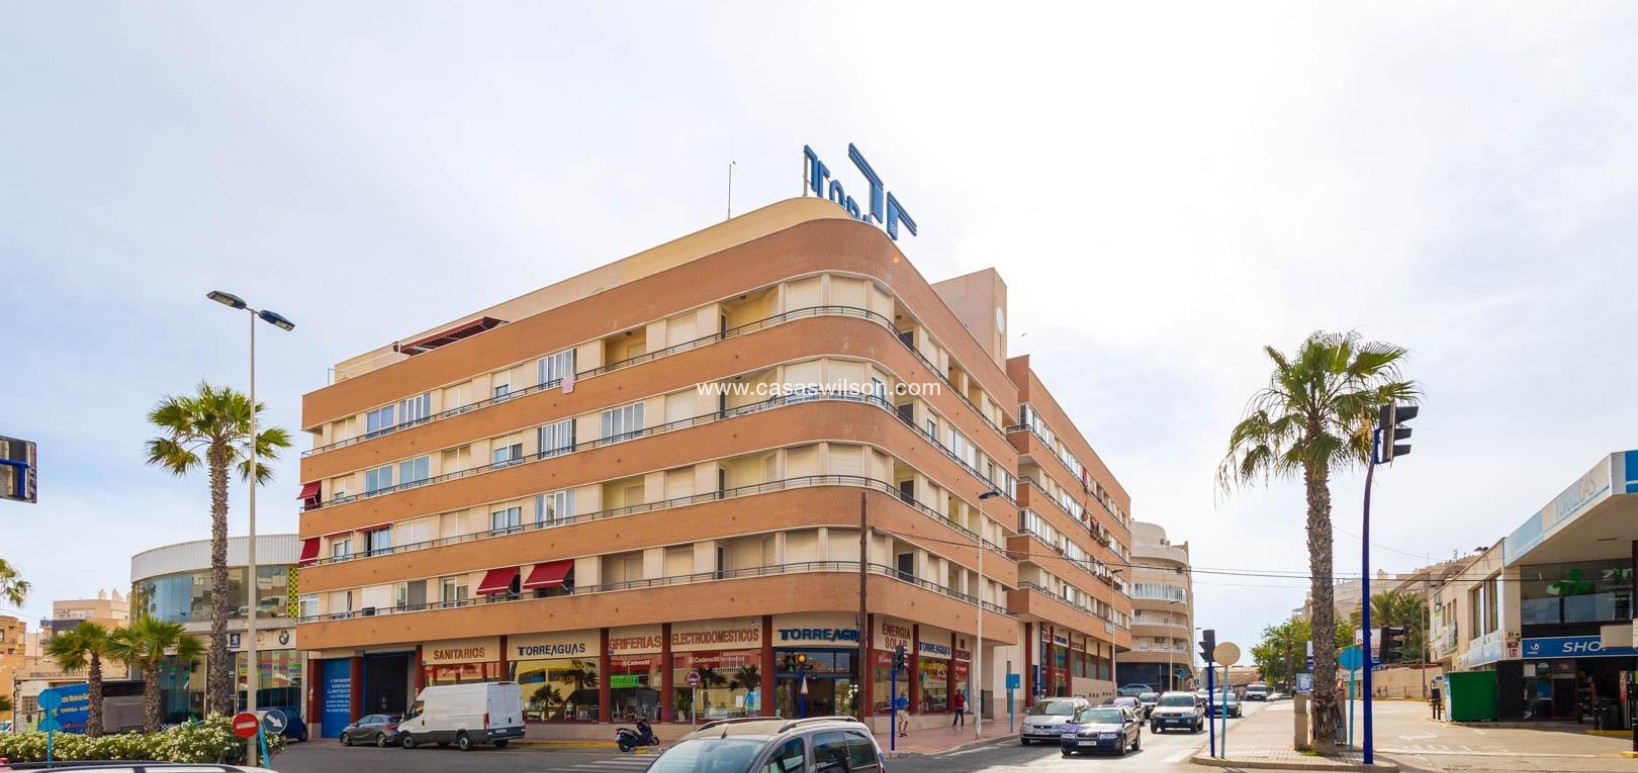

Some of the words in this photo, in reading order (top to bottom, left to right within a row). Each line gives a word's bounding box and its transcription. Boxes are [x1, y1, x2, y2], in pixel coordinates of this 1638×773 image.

[434, 646, 485, 660] SANITARIOS
[517, 643, 586, 656] TORREAGUAS
[1562, 641, 1607, 653] SHO
